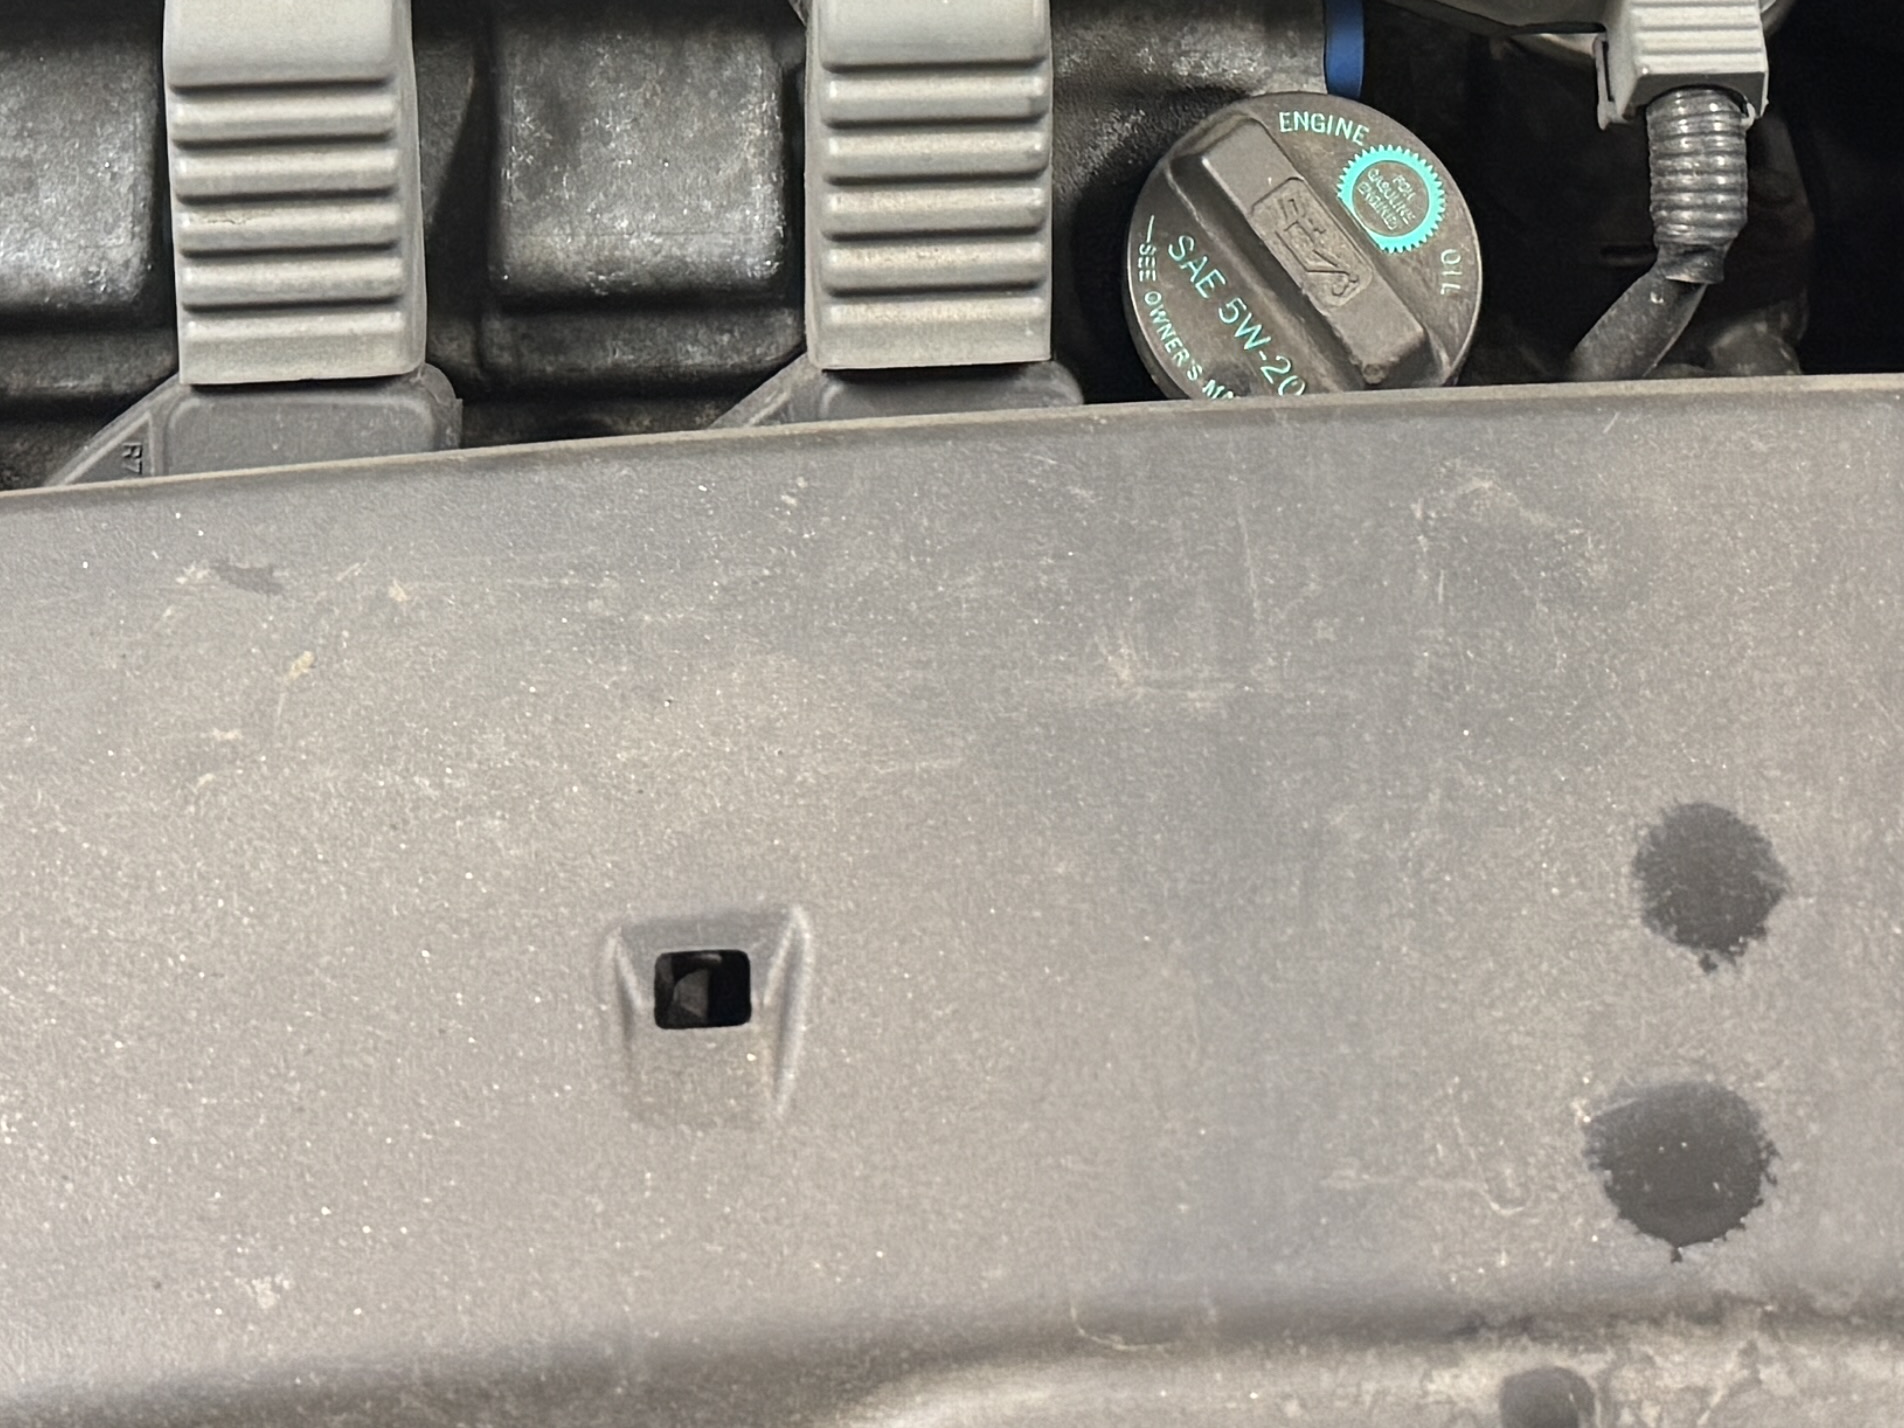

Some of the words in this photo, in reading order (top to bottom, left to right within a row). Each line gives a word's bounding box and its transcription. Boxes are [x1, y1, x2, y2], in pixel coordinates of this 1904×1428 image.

[1279, 110, 1370, 146] ENGINE
[1439, 248, 1463, 295] OIL
[1168, 235, 1226, 299] SAE
[1144, 291, 1203, 382] OWNER'S
